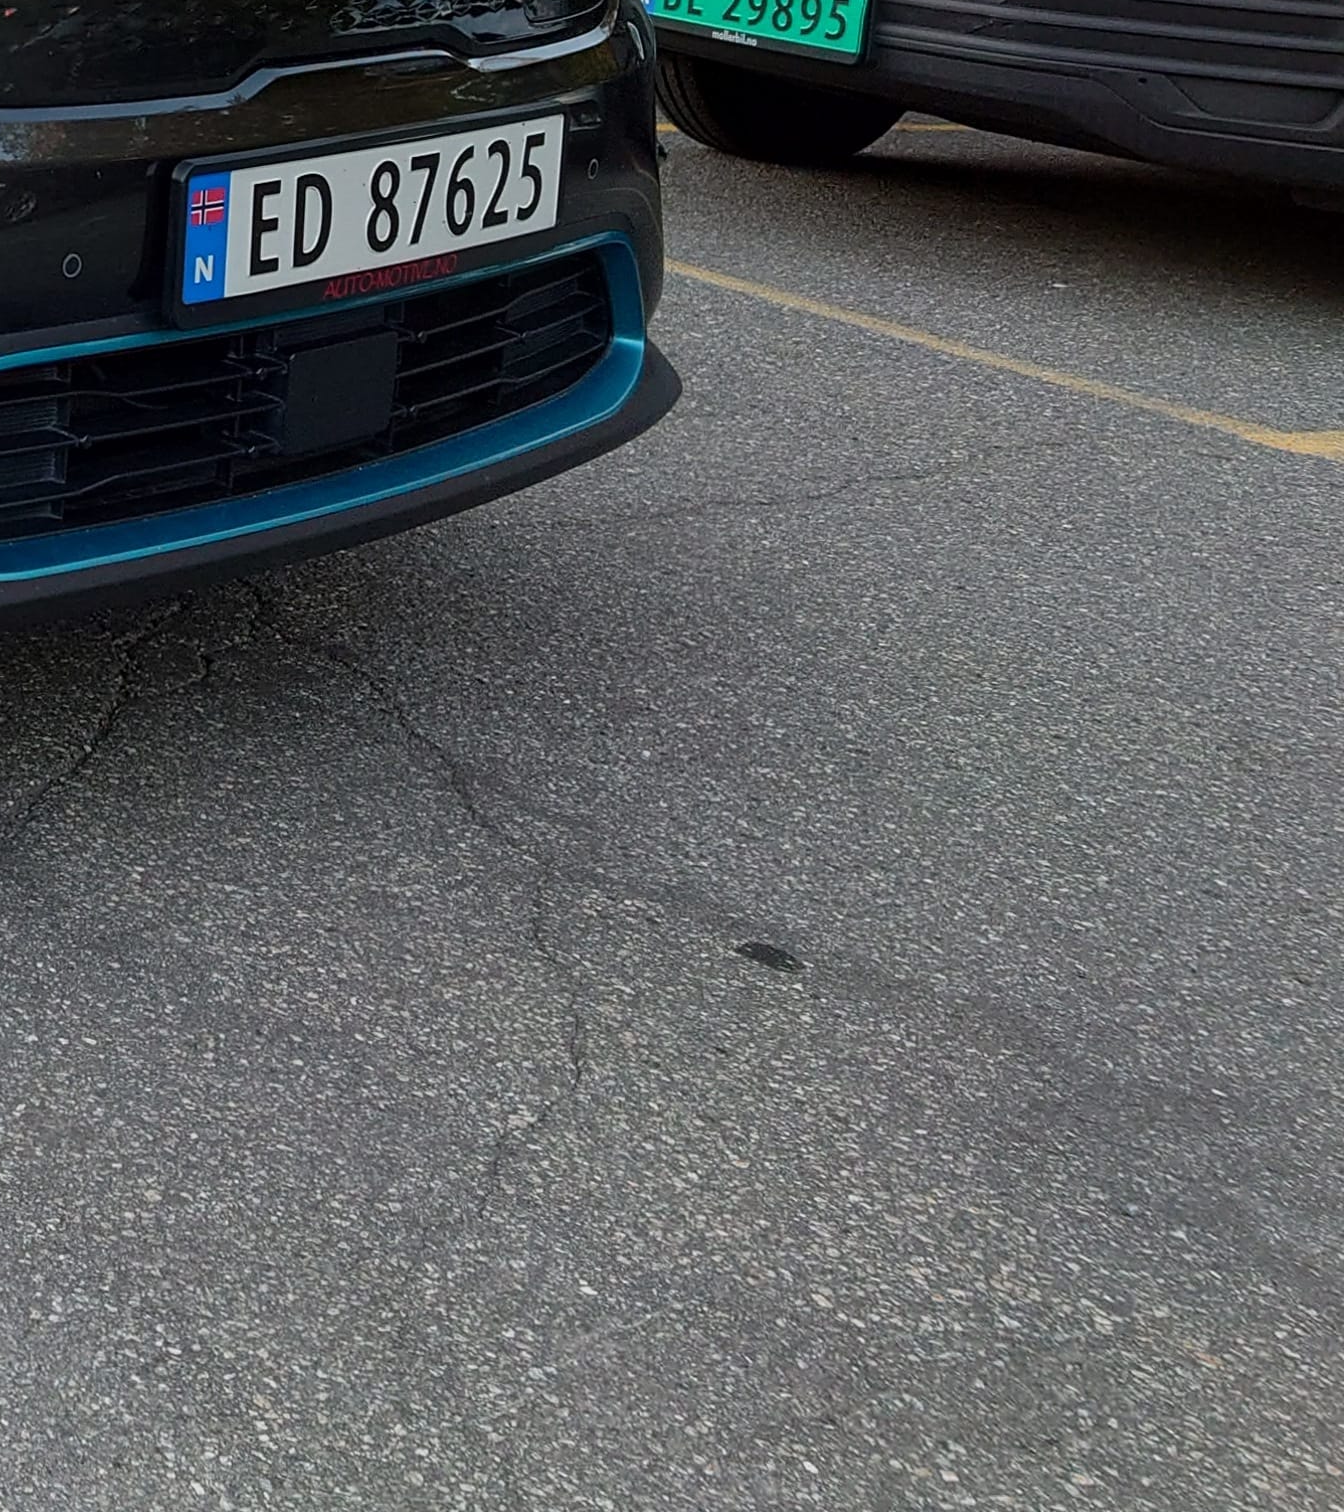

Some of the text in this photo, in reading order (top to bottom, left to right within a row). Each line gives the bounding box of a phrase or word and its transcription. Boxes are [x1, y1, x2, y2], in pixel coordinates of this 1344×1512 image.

[194, 131, 546, 284] N ED 87625
